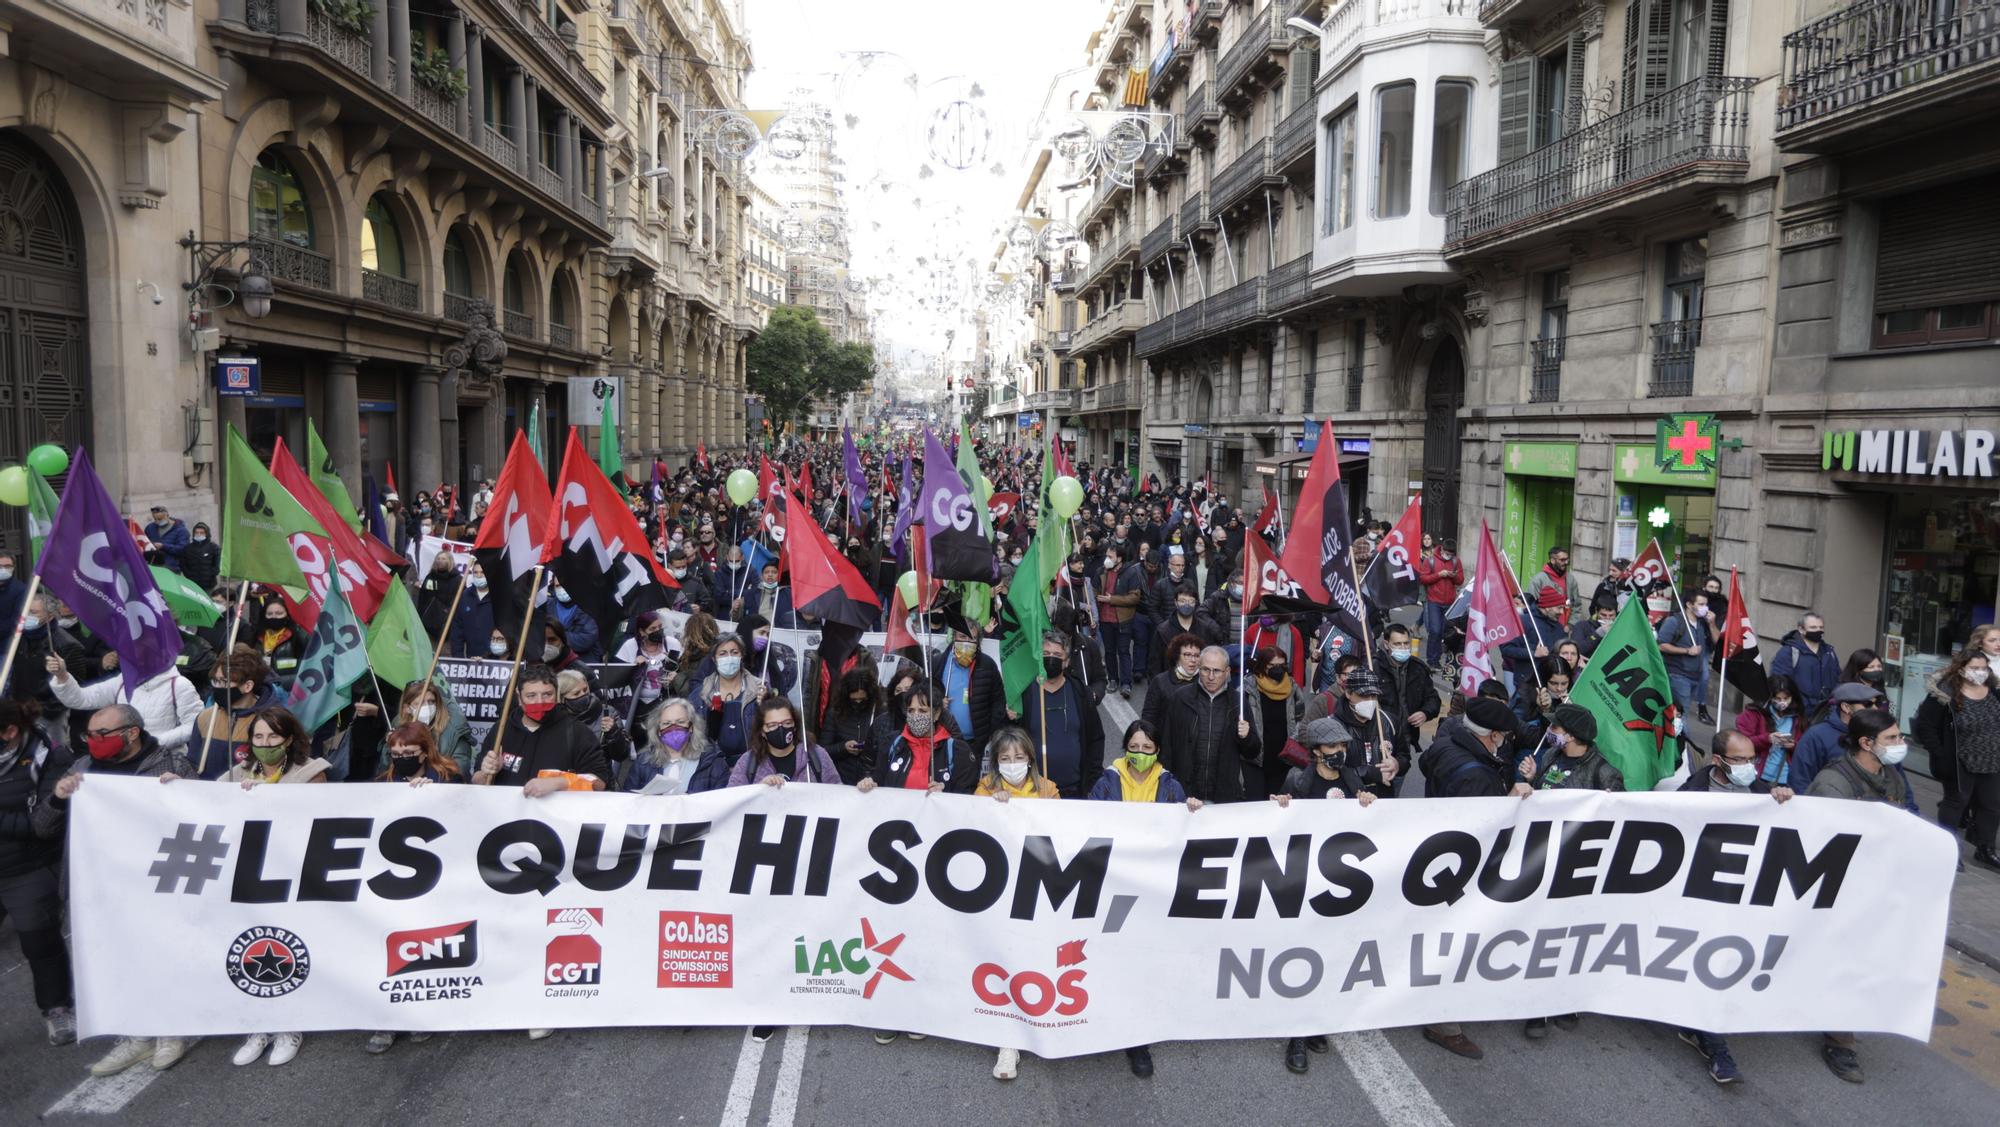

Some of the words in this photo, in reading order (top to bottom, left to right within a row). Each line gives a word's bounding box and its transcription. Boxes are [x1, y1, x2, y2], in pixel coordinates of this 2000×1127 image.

[1858, 430, 1995, 477] MILAR
[1508, 482, 1520, 564] FARMAC
[476, 818, 712, 897] QUE
[729, 813, 840, 897] HI
[858, 819, 1139, 933] SOM,
[1168, 831, 1379, 919] ENS
[1401, 820, 1862, 910] QUEDEM
[664, 915, 729, 944] co.bas
[228, 927, 308, 966] SOLIDARITAT
[398, 934, 466, 963] CNT
[663, 949, 711, 961] SINDICAT
[713, 951, 729, 962] DE
[662, 961, 729, 972] COMISSIONS
[1216, 946, 1325, 999] NO
[1340, 939, 1387, 993] A
[1410, 922, 1789, 992] L'ICETAZO!
[546, 962, 600, 984] CGT
[672, 972, 686, 982] DE
[688, 973, 719, 983] BASE
[806, 978, 846, 986] INTERSINDICAL
[237, 976, 303, 997] OBRERA
[379, 976, 484, 993] CATALUNYA
[544, 988, 600, 998] Catalunya
[789, 986, 824, 994] ALTERNATIVA
[832, 988, 861, 996] CATALUNYA
[389, 988, 472, 1004] BALEARS
[974, 1007, 1027, 1023] COORDINADORA
[1027, 1019, 1056, 1028] OBRERA
[1057, 1018, 1089, 1028] SINDICAL
